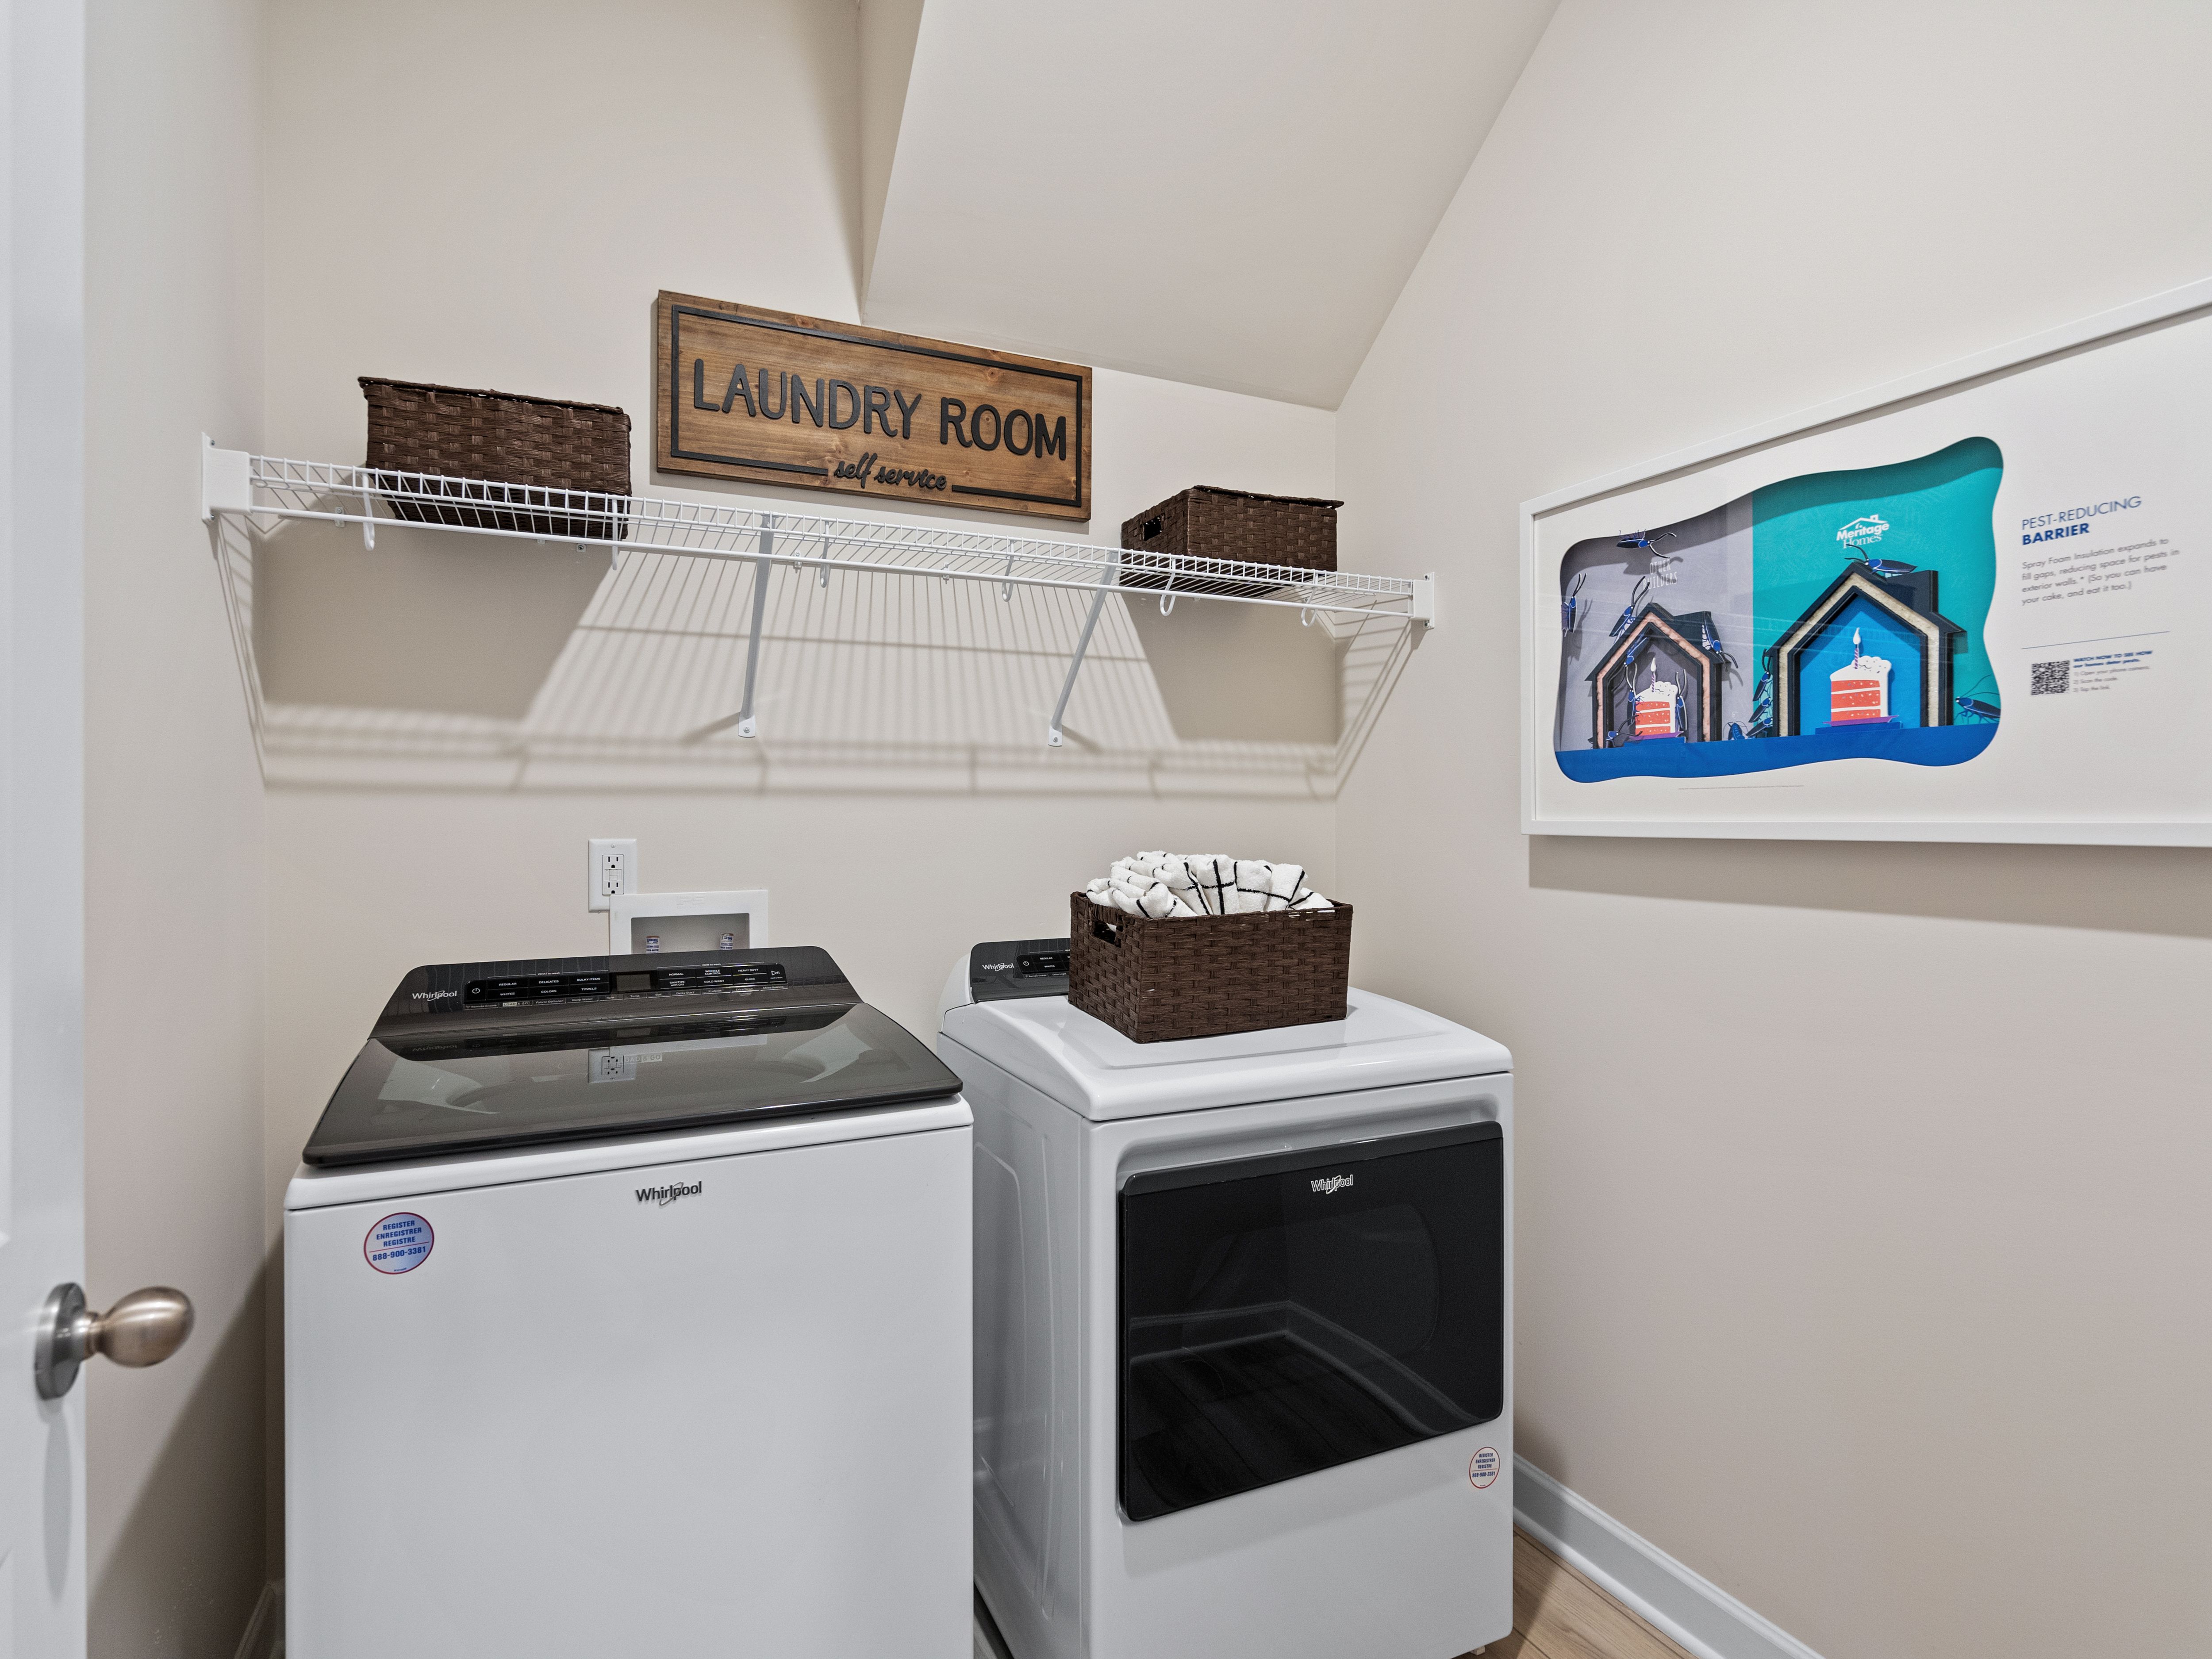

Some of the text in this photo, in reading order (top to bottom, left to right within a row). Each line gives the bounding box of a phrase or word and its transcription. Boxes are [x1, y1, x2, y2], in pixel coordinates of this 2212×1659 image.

[694, 359, 1066, 460] LAUNDRY ROOM
[834, 452, 947, 490] self service
[2022, 496, 2142, 530] PEST-REDUCING
[1836, 523, 1889, 541] Meritage
[2022, 523, 2089, 545] BARRIER
[1843, 535, 1882, 549] Homes
[2022, 561, 2046, 570] Spray
[2074, 549, 2114, 559] Insulation
[2117, 539, 2157, 552] expands
[1650, 559, 1671, 575] OTHER
[2034, 572, 2056, 580] gaps,
[2059, 564, 2096, 574] reducing
[2100, 559, 2125, 569] space
[2144, 552, 2167, 562] pests
[1643, 572, 1677, 590] BUILDERS
[2022, 584, 2052, 592] exterior
[2105, 572, 2121, 581] you
[2067, 588, 2084, 597] and
[982, 963, 1014, 972] Whirlpool
[412, 991, 457, 1001] Whirlpool
[1311, 1174, 1353, 1194] Whirlpool
[636, 1181, 702, 1206] Whirlpool
[376, 1227, 422, 1240] ENREGISTRER
[383, 1220, 415, 1231] REGISTER
[383, 1237, 416, 1247] REGISTRE
[373, 1246, 426, 1261] 888-900-3381
